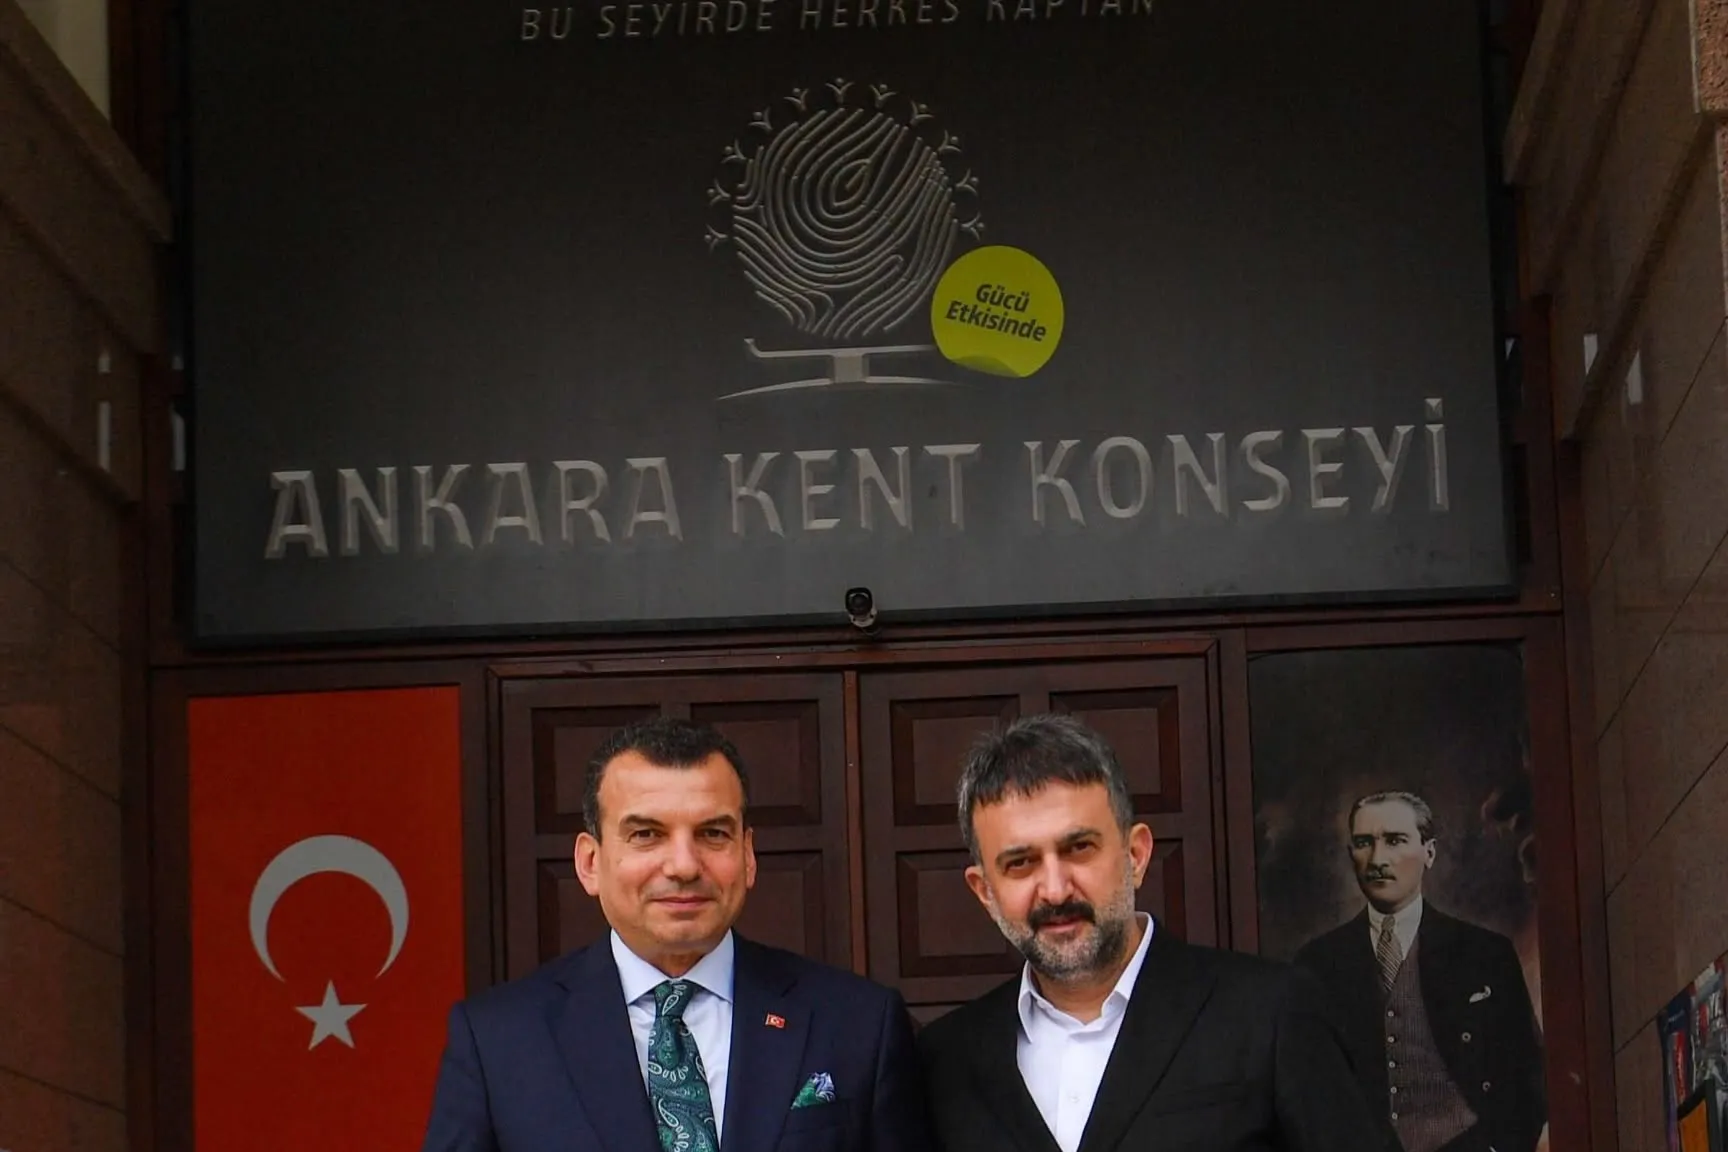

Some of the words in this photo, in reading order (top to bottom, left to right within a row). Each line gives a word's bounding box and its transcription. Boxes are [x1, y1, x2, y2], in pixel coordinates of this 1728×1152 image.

[521, 7, 573, 40] BU
[800, 0, 960, 30] HERKES
[975, 283, 1030, 313] Gücü
[945, 301, 1047, 342] Etkisinde
[264, 456, 684, 559] ANKARA
[723, 442, 982, 538] KENT
[1023, 397, 1449, 528] KONSEYİ
